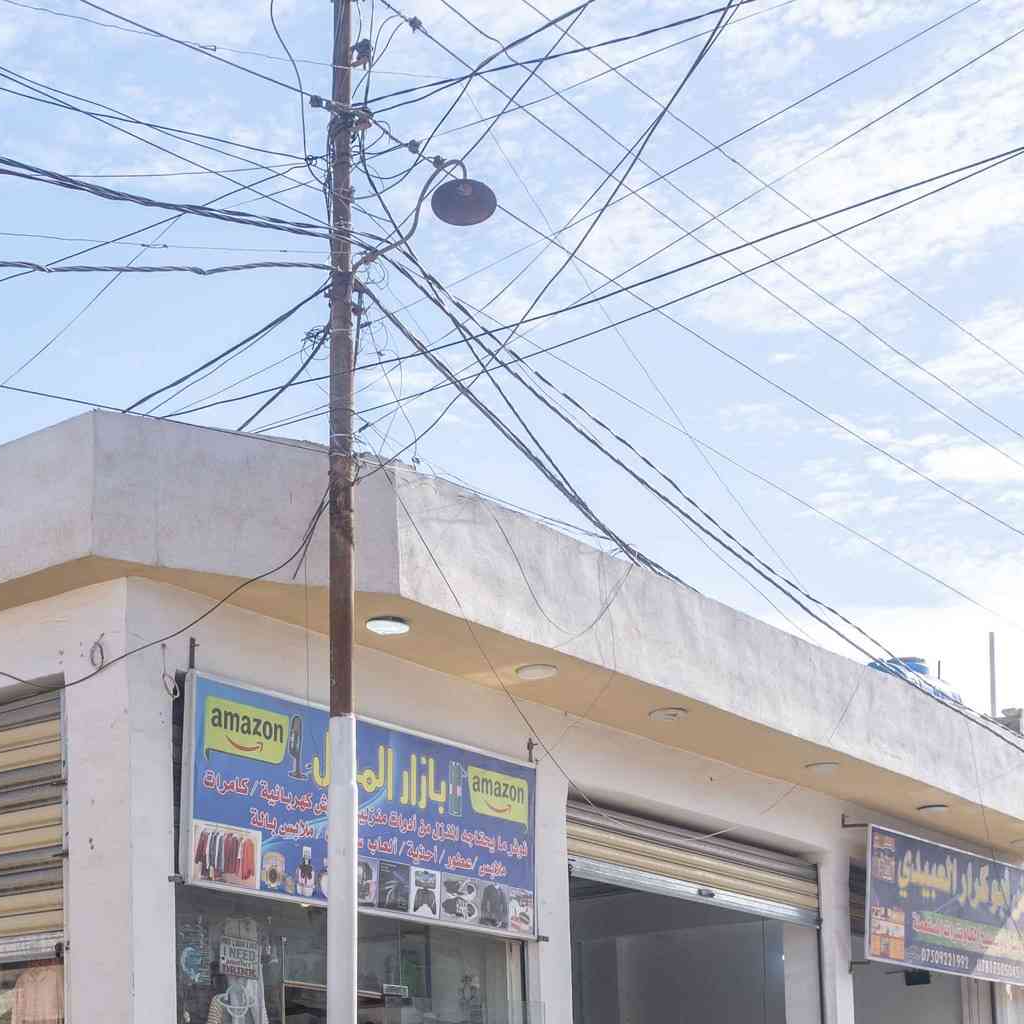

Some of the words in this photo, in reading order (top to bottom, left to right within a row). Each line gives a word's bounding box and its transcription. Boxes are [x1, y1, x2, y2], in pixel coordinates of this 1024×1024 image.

[211, 707, 284, 743] amazon
[399, 753, 447, 815] بازار
[472, 774, 525, 805] amazon
[278, 818, 314, 840] ملابس
[417, 818, 432, 838] من
[432, 820, 460, 842] المنزل
[479, 861, 507, 880] ملابس
